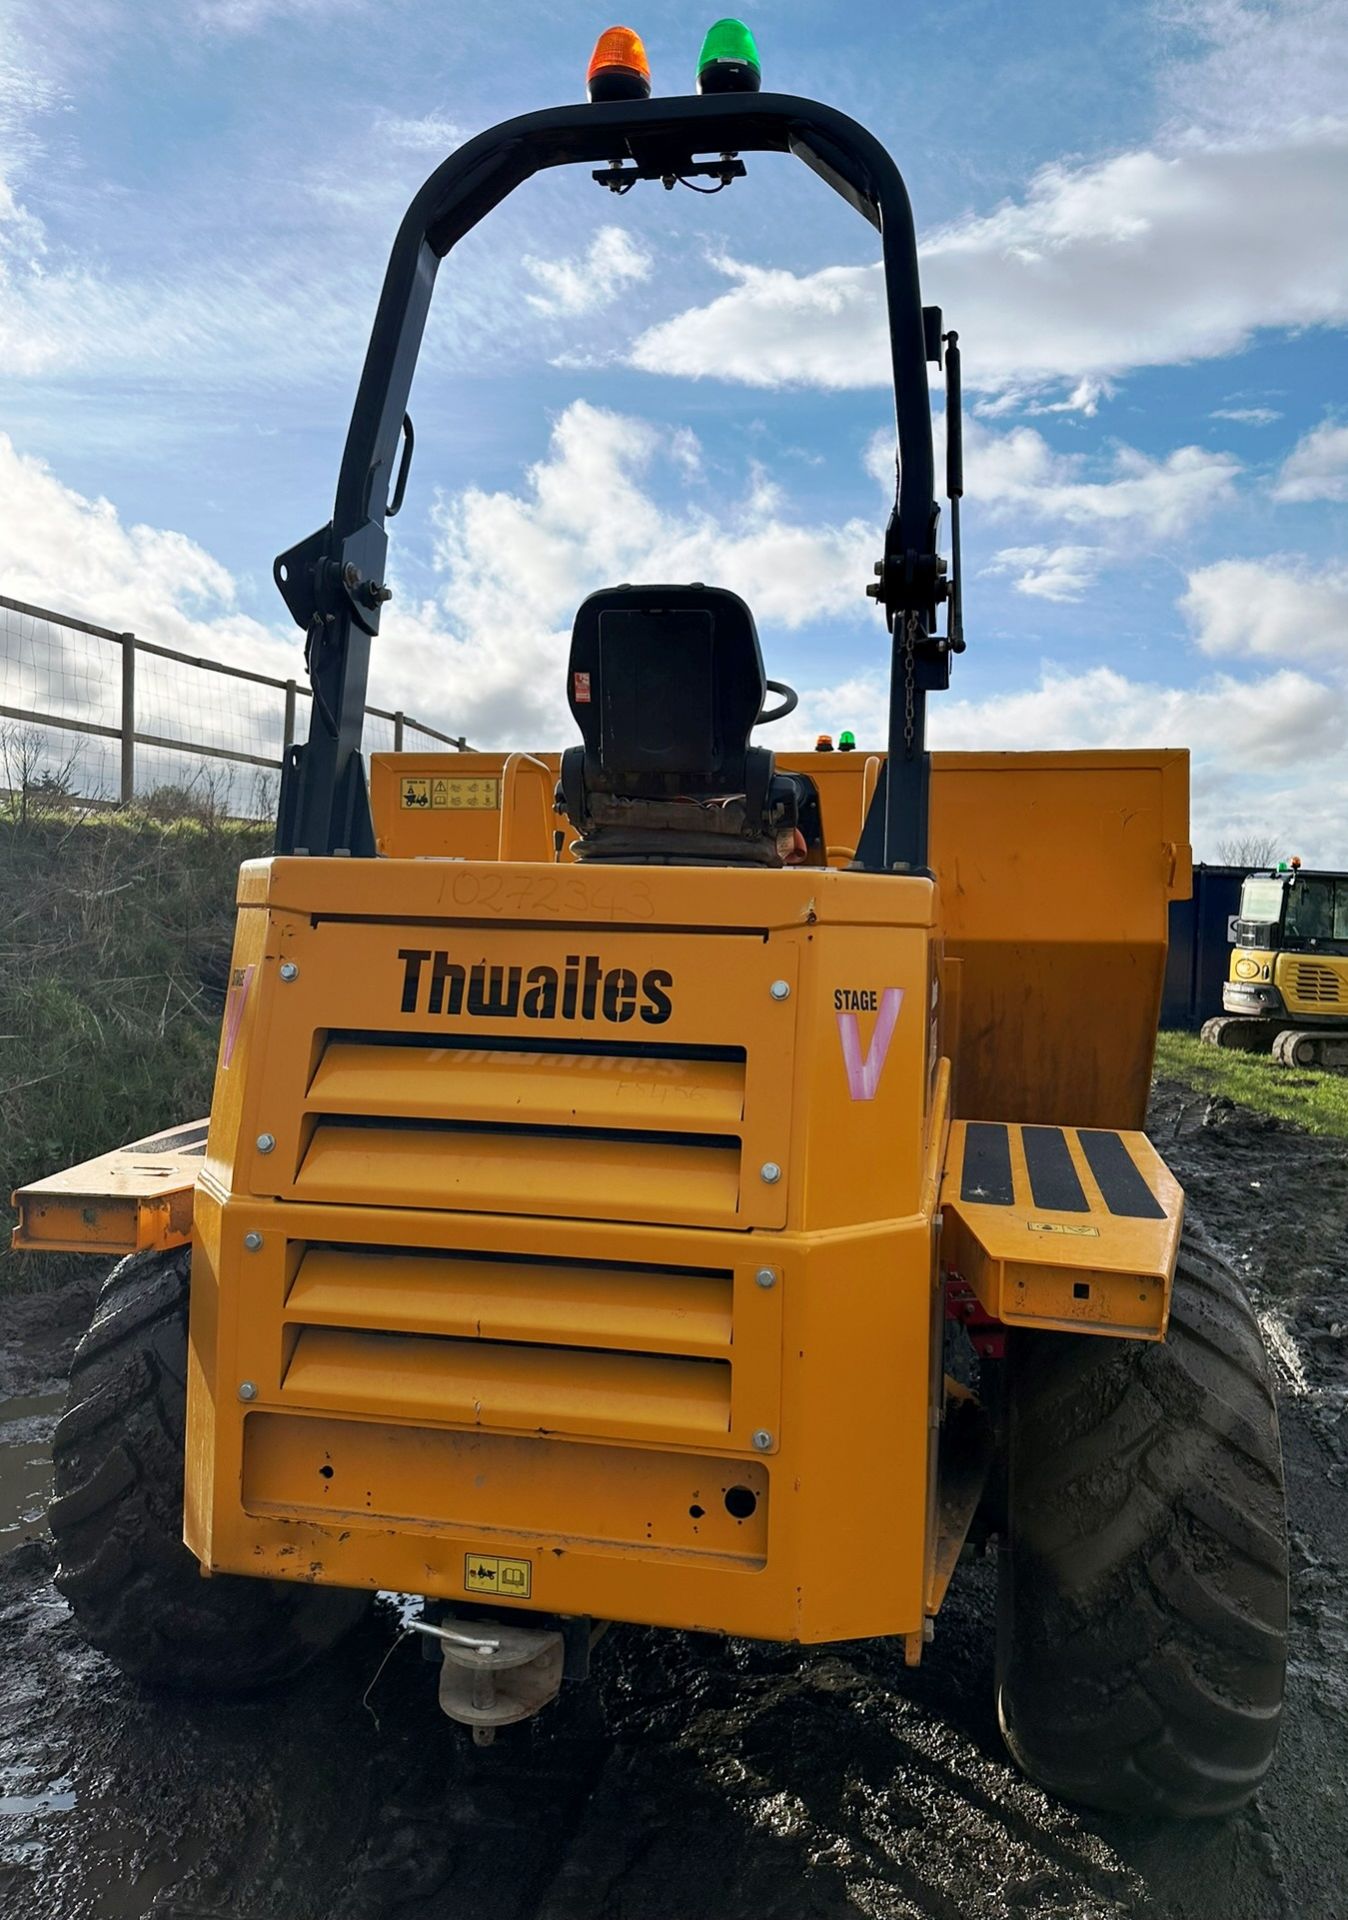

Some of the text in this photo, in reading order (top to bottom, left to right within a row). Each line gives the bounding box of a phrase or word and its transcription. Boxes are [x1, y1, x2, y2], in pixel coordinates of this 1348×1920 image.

[398, 949, 673, 1025] Thwaites
[834, 988, 878, 1011] STAGE
[835, 987, 905, 1102] V
